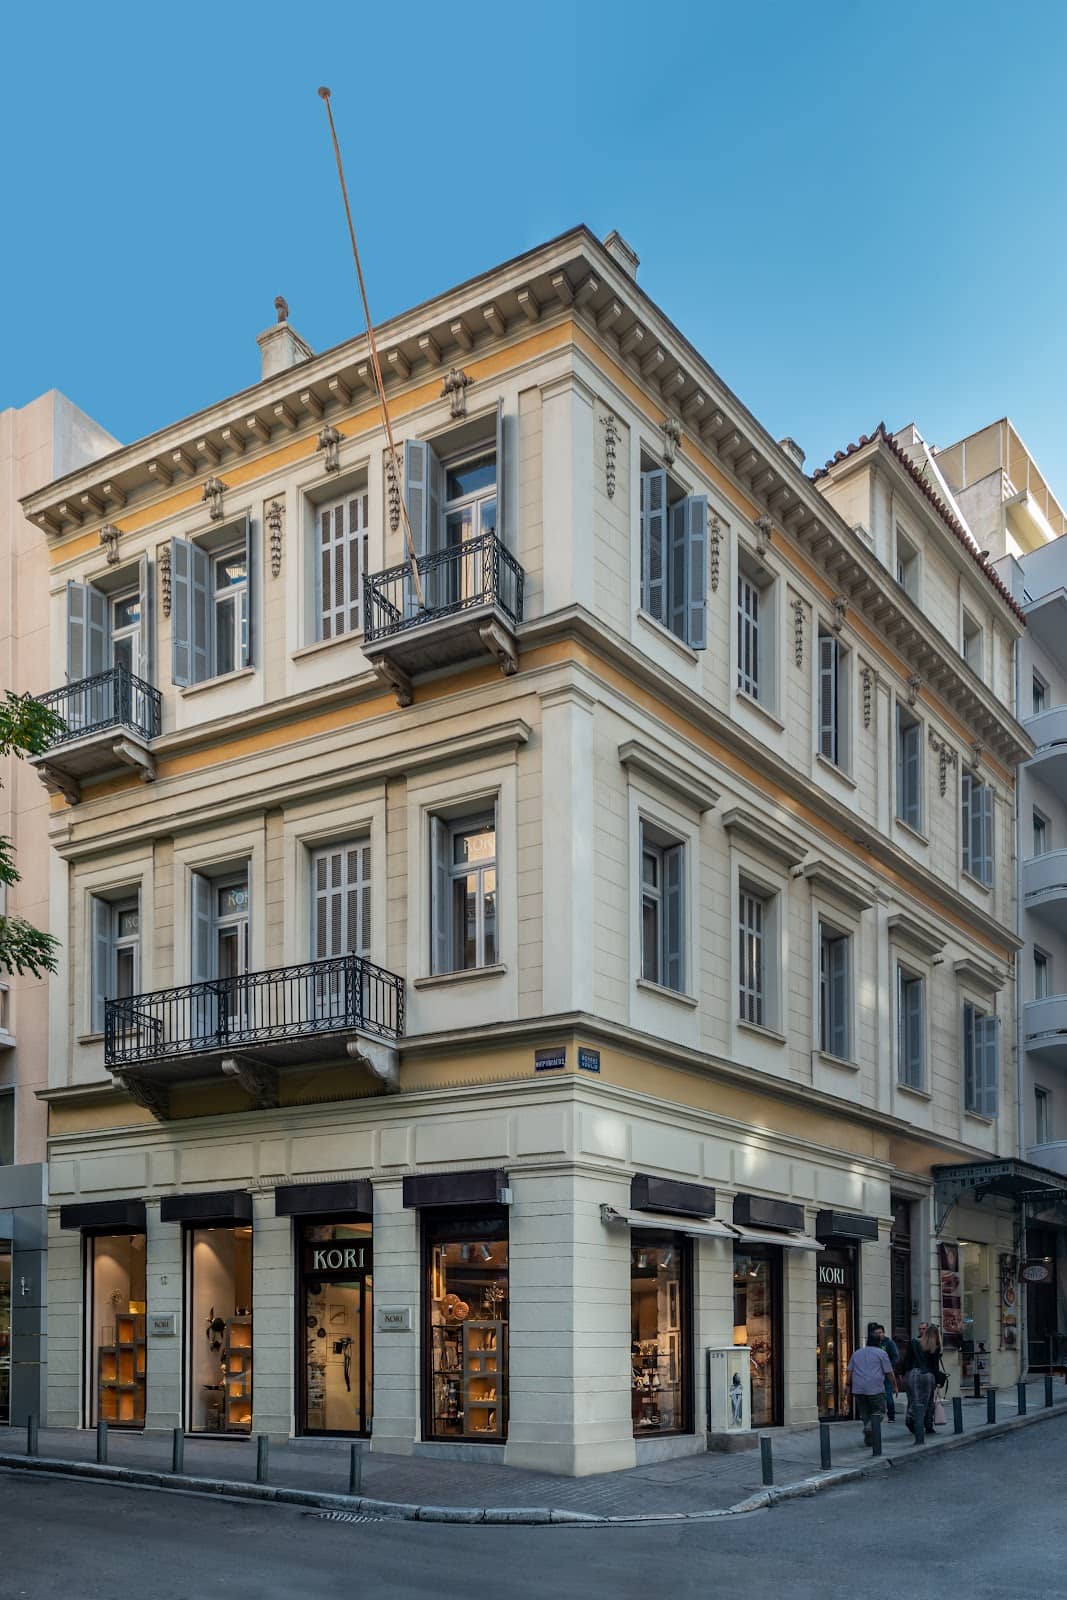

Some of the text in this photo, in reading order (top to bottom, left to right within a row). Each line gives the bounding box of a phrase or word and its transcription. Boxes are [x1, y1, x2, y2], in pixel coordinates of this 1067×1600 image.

[313, 1248, 365, 1270] KORI
[819, 1266, 845, 1285] KORI
[154, 1320, 169, 1329] KORI
[384, 1314, 403, 1323] KORI
